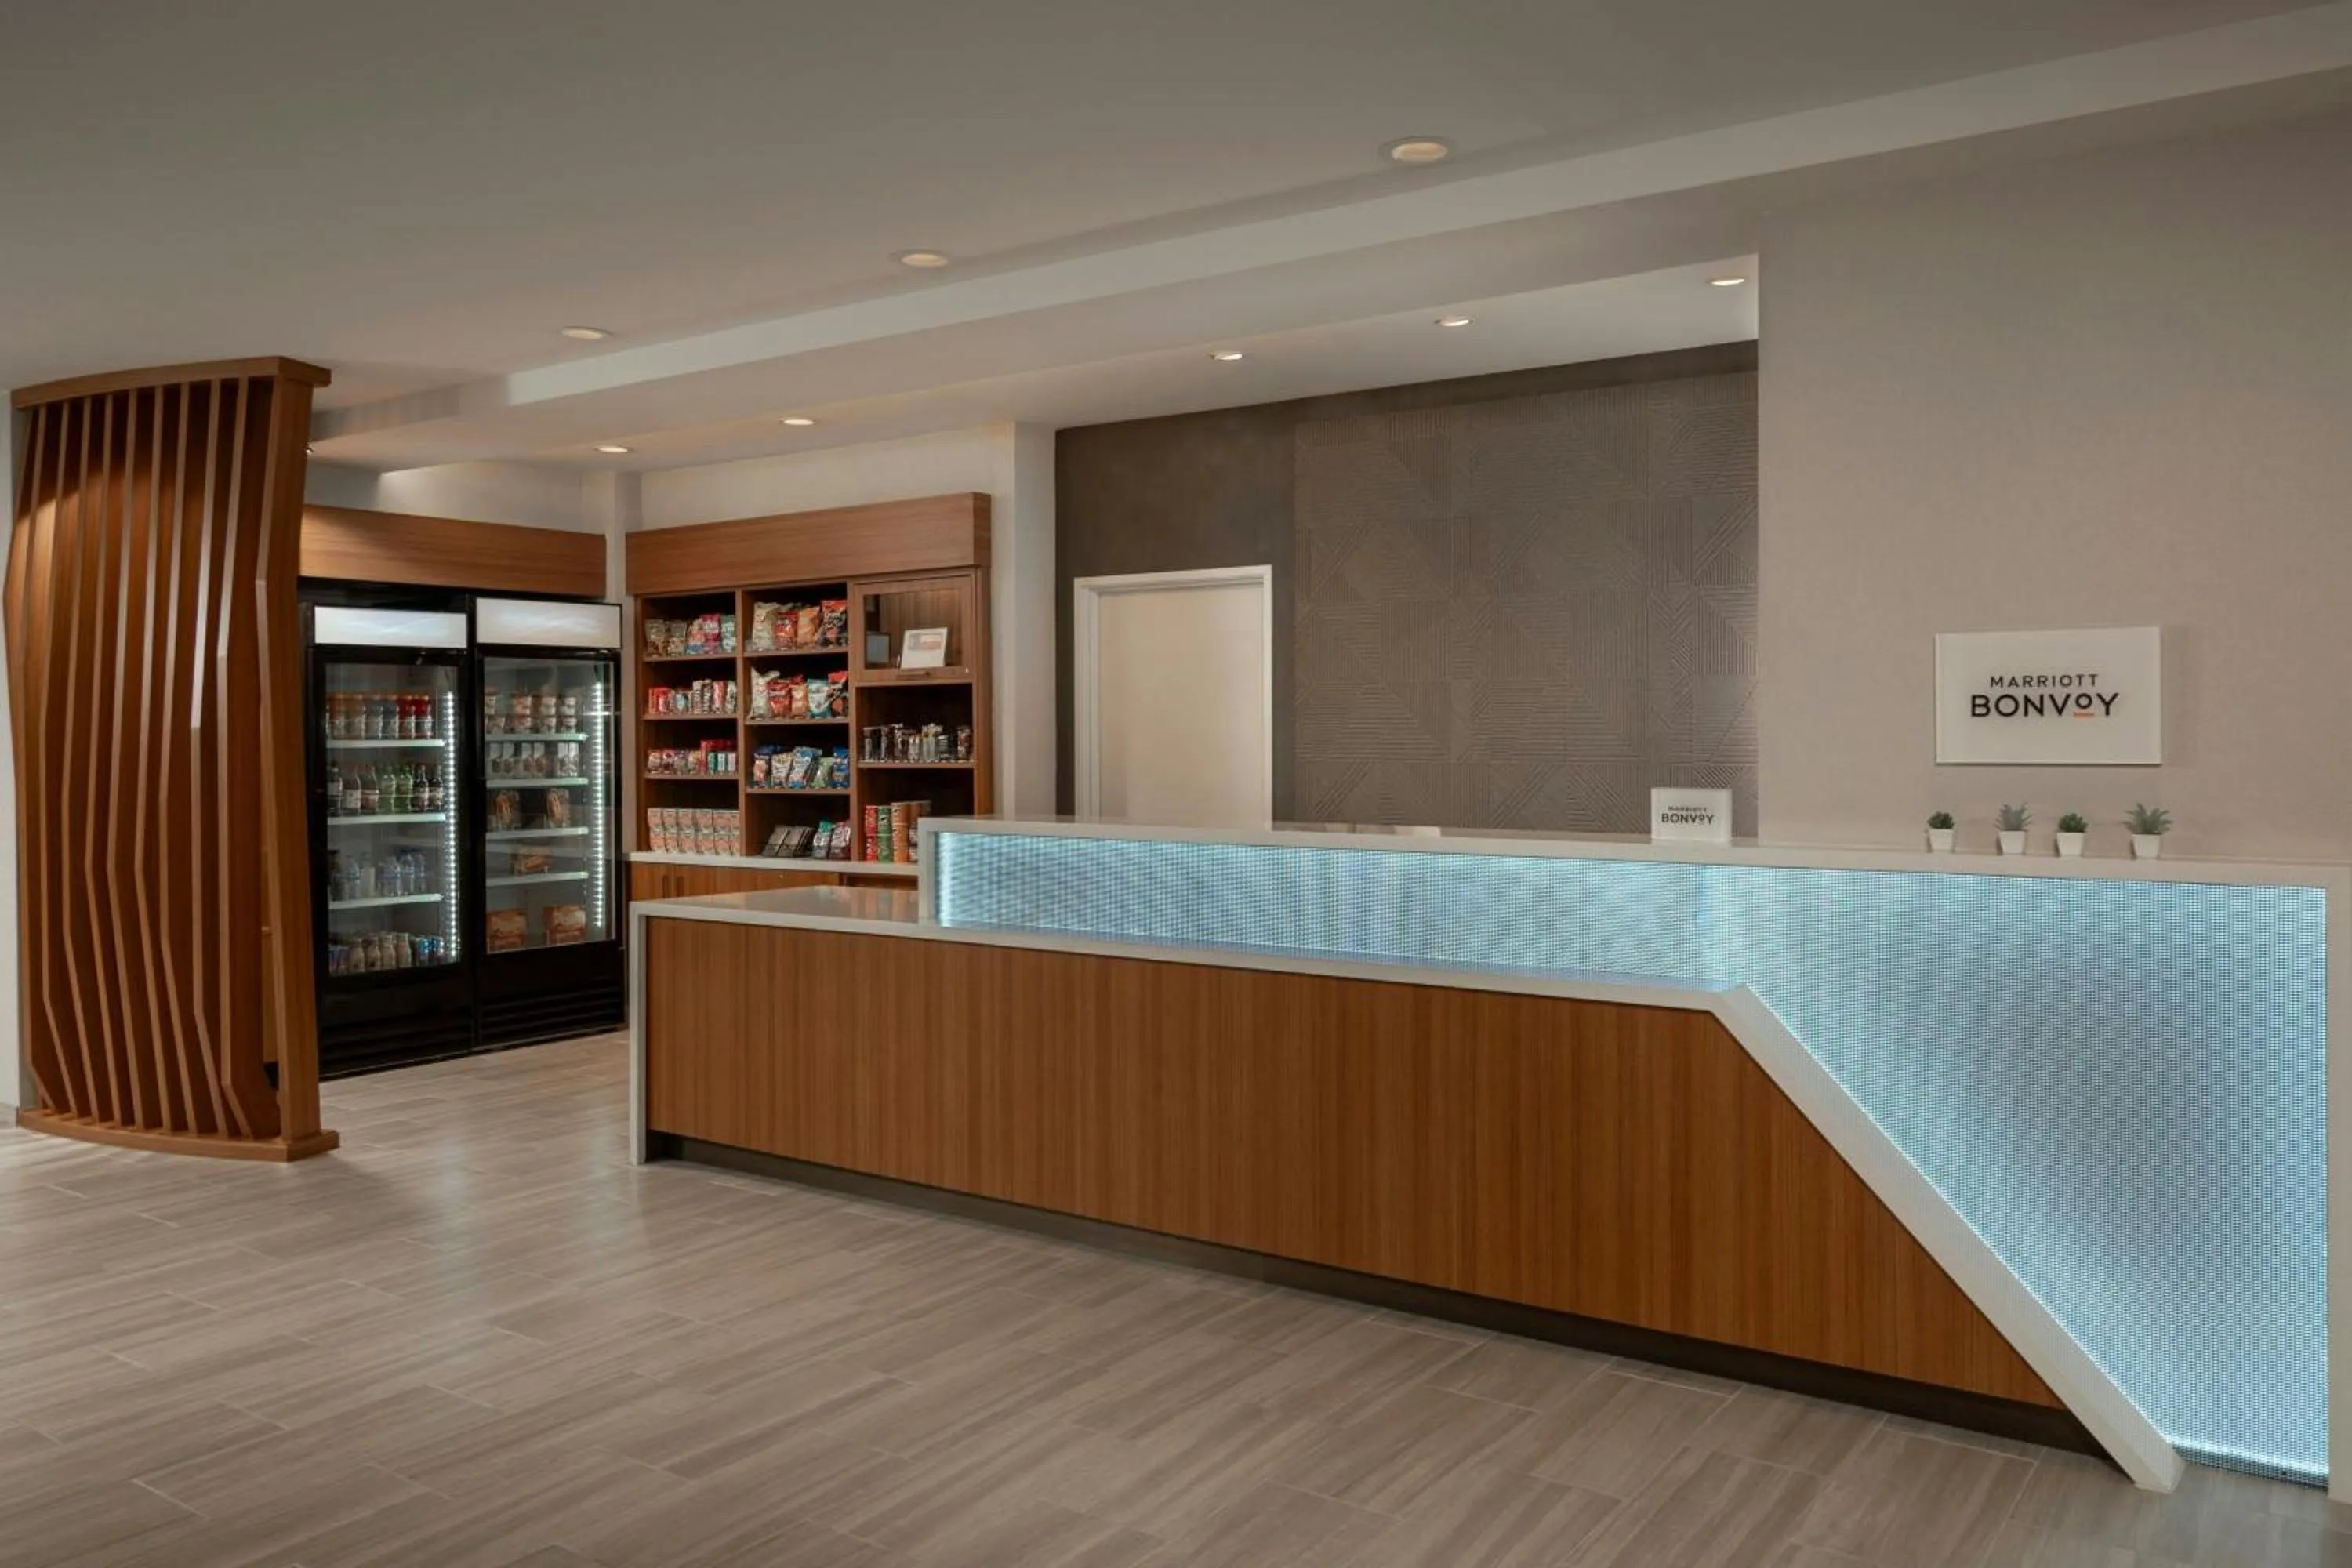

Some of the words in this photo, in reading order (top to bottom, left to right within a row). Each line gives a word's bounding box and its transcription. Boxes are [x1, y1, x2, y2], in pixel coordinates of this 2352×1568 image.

[1990, 674, 2098, 688] MARRIOTT
[1971, 692, 2119, 717] BONVOY
[1661, 813, 1714, 825] BONVOY
